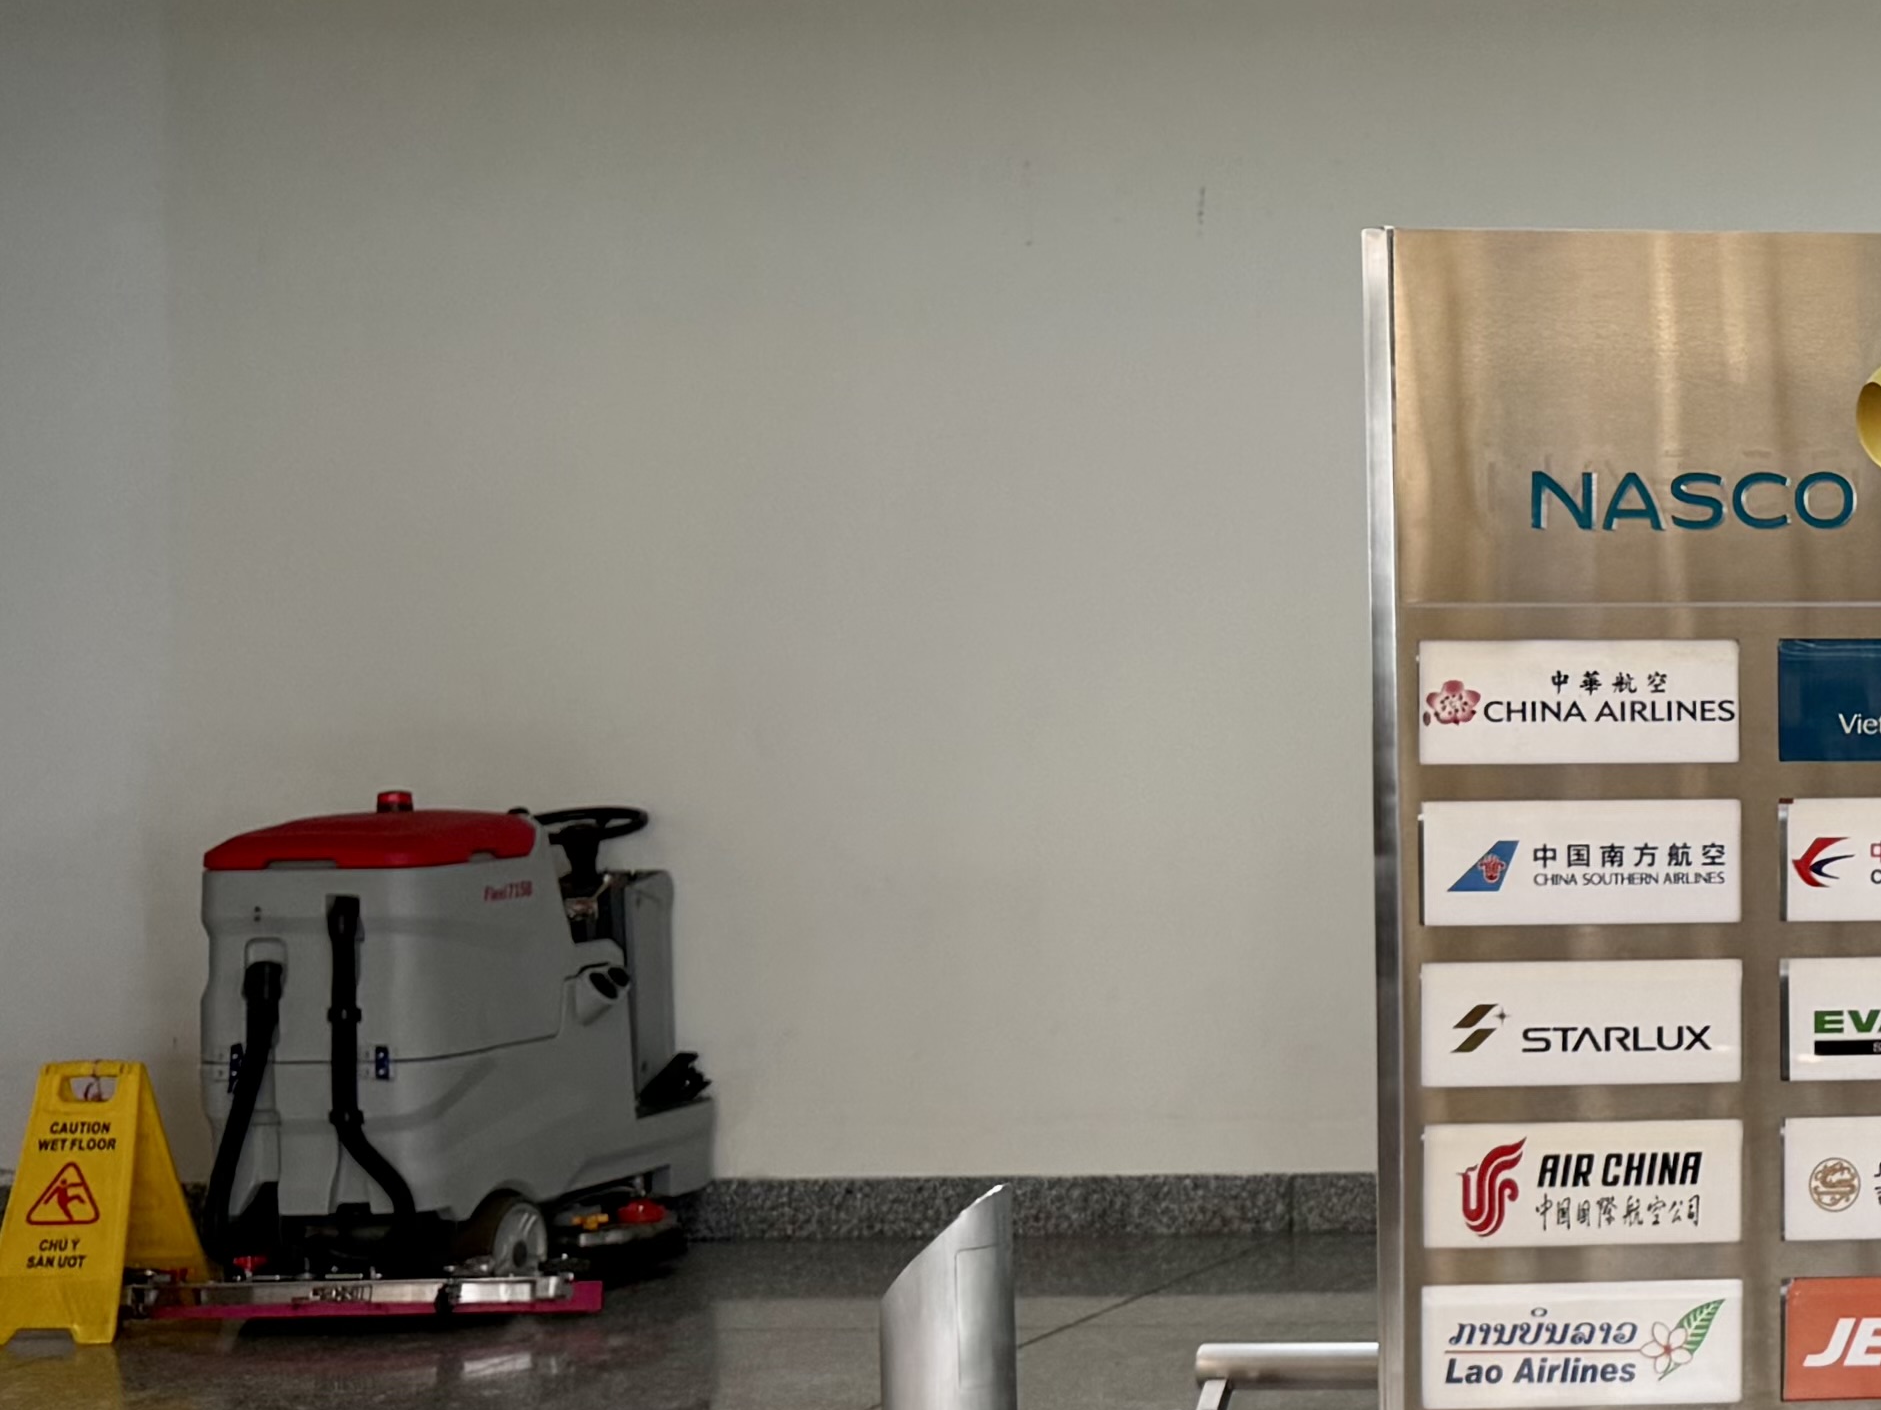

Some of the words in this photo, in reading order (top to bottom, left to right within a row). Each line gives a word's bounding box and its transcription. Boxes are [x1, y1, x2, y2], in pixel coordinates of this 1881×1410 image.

[1530, 469, 1856, 530] NASCO
[1552, 670, 1667, 694] 中華航空
[1484, 701, 1586, 722] CHINA
[1595, 700, 1735, 722] AIRLINES
[1533, 843, 1725, 868] 中国南方航空
[1534, 873, 1578, 886] CHINA
[1583, 872, 1658, 885] SOUTHERN
[1664, 872, 1725, 885] AIRLINES
[1522, 1026, 1712, 1053] STARLUX
[50, 1121, 110, 1134] CAUTION
[38, 1139, 68, 1151] WET
[70, 1139, 116, 1151] FLOOR
[1537, 1154, 1594, 1188] AIR
[1601, 1152, 1702, 1187] CHINA
[1445, 1358, 1503, 1384] Lao
[1513, 1358, 1635, 1383] Airlines
